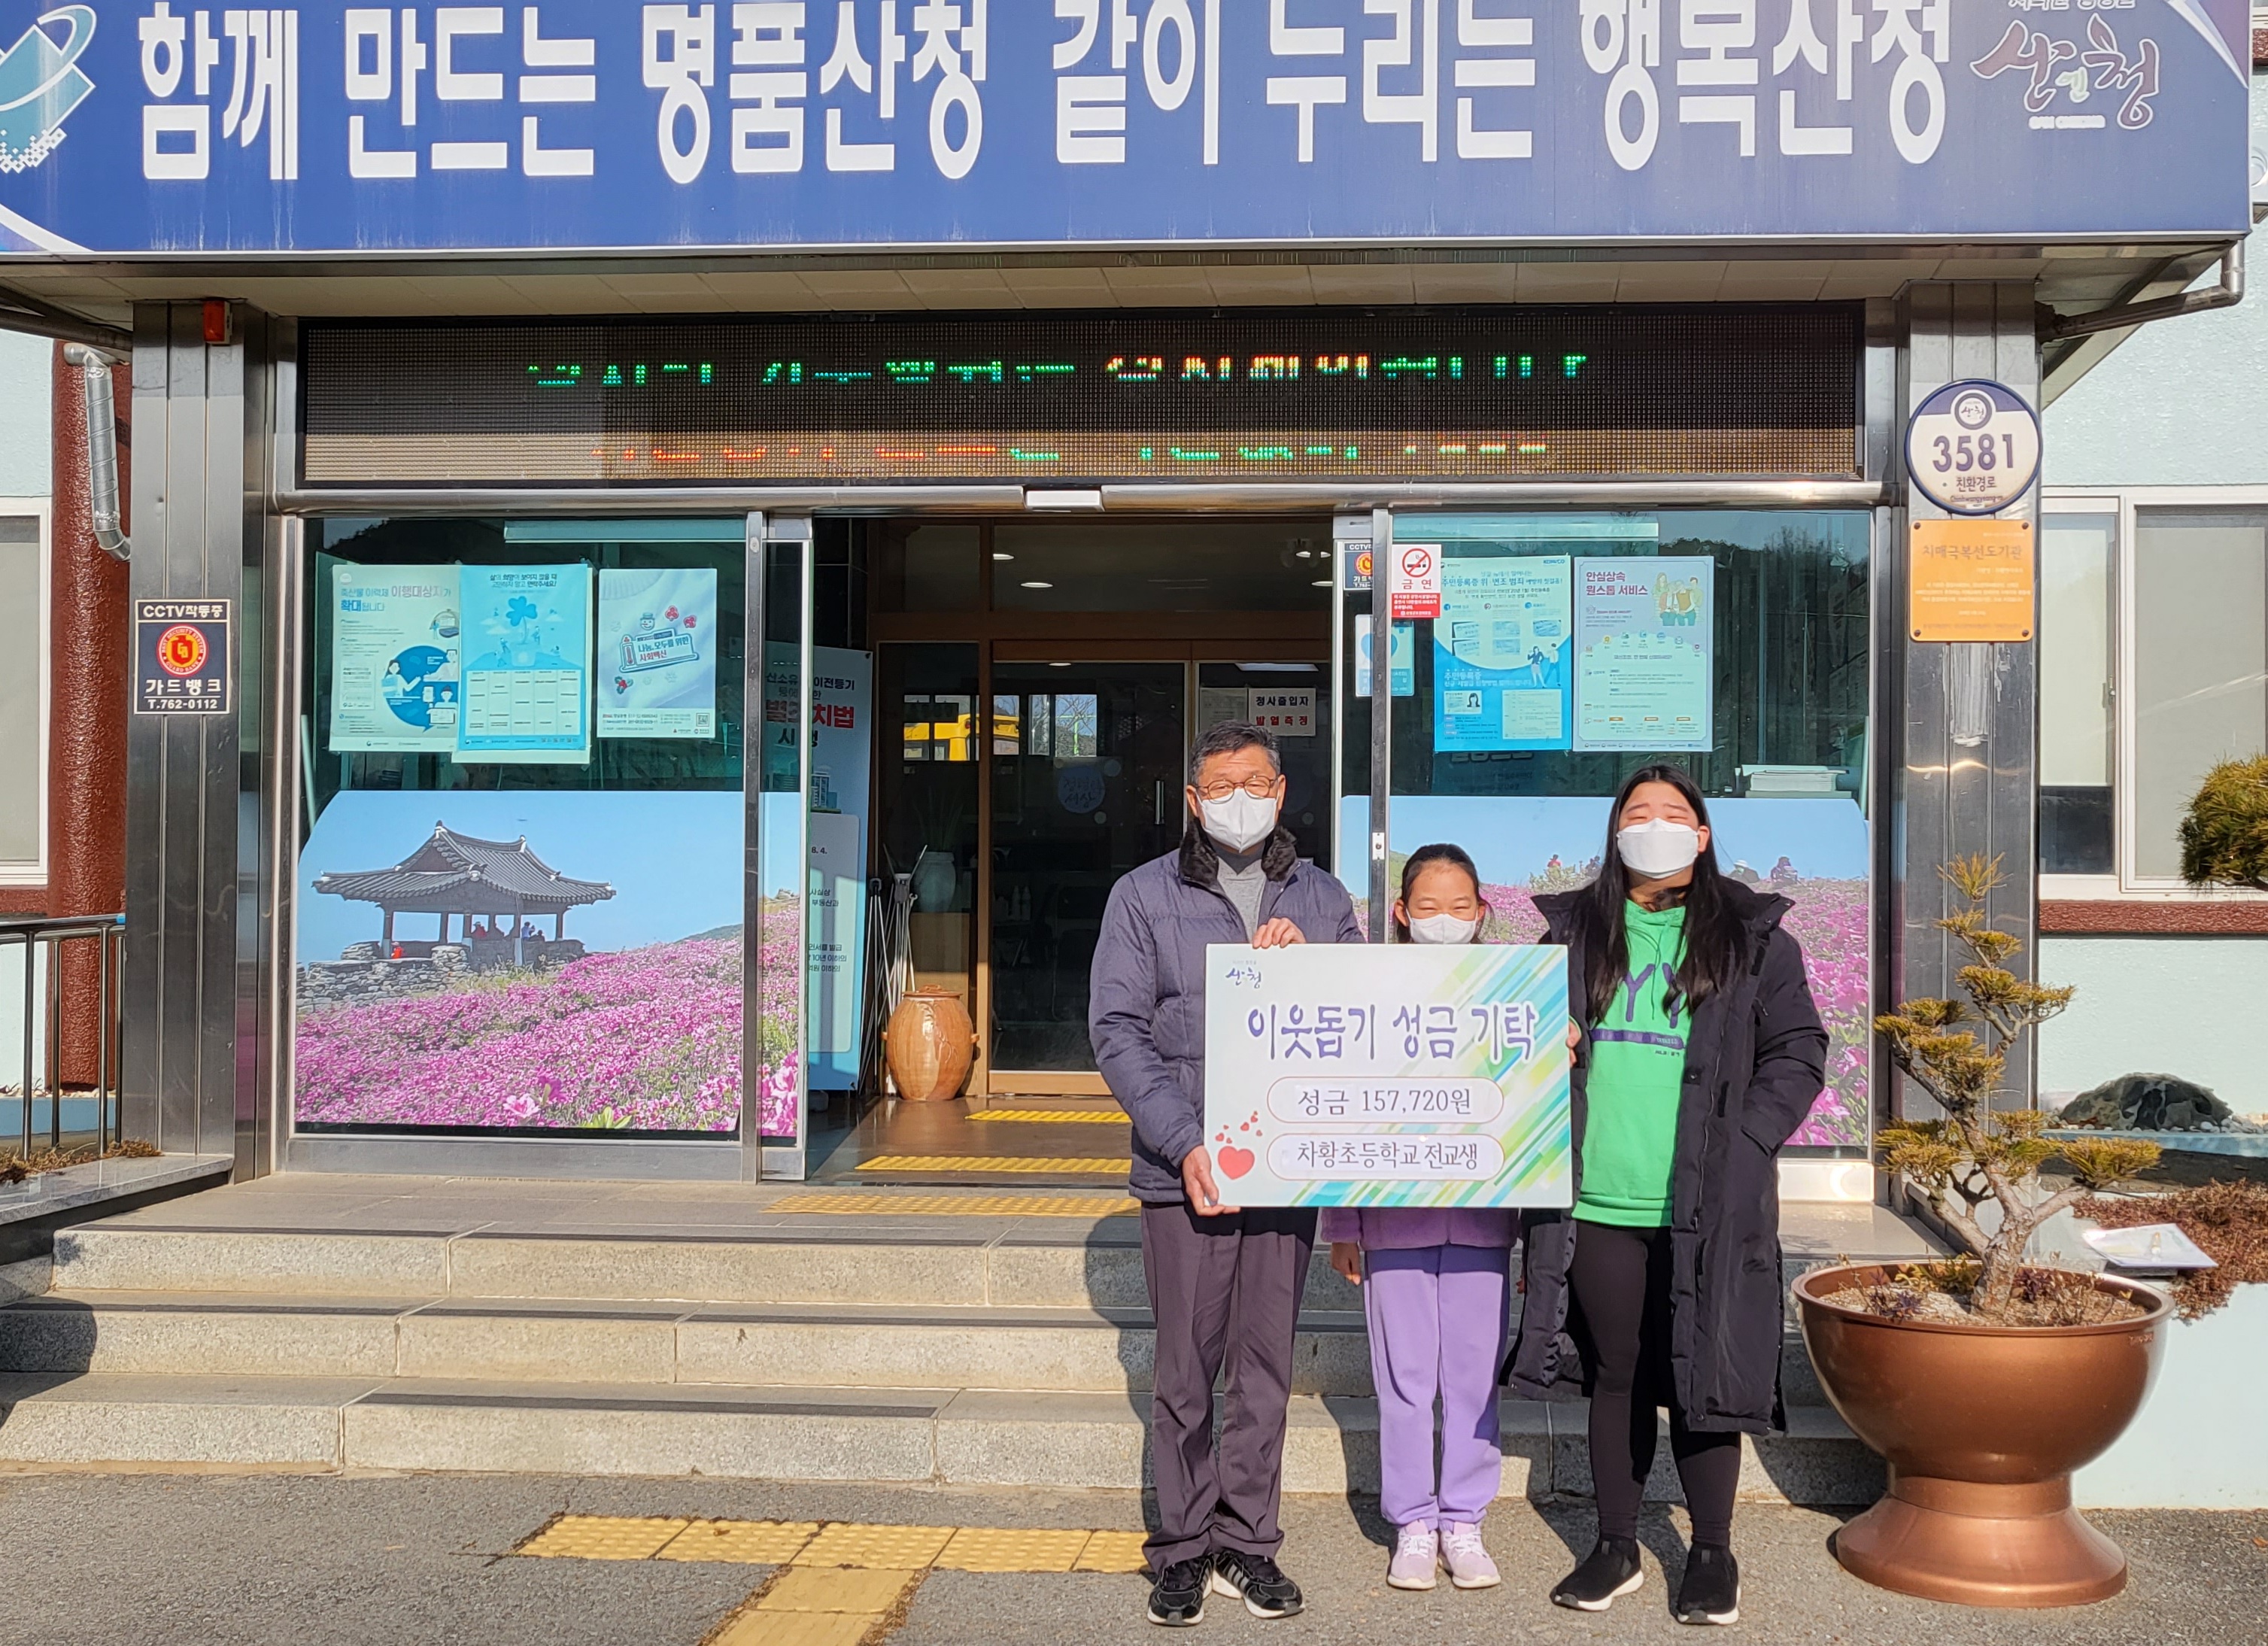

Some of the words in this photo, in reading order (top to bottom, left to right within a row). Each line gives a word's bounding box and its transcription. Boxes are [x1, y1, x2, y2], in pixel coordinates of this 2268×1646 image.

[138, 2, 298, 180] 함께
[345, 7, 595, 178] 만드는
[642, 0, 987, 184] 명품산청
[1053, 0, 1218, 165] 같이
[1267, 0, 1536, 162] 누리는
[1580, 0, 1950, 171] 행복산청
[1933, 433, 2014, 472] 3581
[1956, 476, 1997, 493] 친환경로
[1922, 544, 2022, 560] 치매극복선도기관
[1586, 572, 1626, 582] 안심상속
[341, 588, 364, 597] 축산물
[366, 588, 389, 597] 이력제
[1586, 585, 1616, 596] 원스톱
[1618, 585, 1648, 596] 서비스
[143, 605, 223, 618] CCTV작동중
[341, 599, 385, 612] 확대됩니다
[146, 679, 221, 695] 가드뱅크
[812, 676, 855, 691] 이전등기
[148, 699, 217, 709] T.762-0112
[820, 846, 827, 855] 4.
[809, 888, 830, 897] 사실상
[812, 899, 839, 907] 부동산과
[1246, 1003, 1376, 1060] 이웃돕기
[1392, 1003, 1458, 1059] 성금
[1470, 1003, 1536, 1061] 기탁
[1298, 1089, 1350, 1116] 성금
[1362, 1089, 1472, 1116] 157,720원
[1297, 1141, 1421, 1170] 차황초등학교
[1423, 1142, 1477, 1170] 전교생
